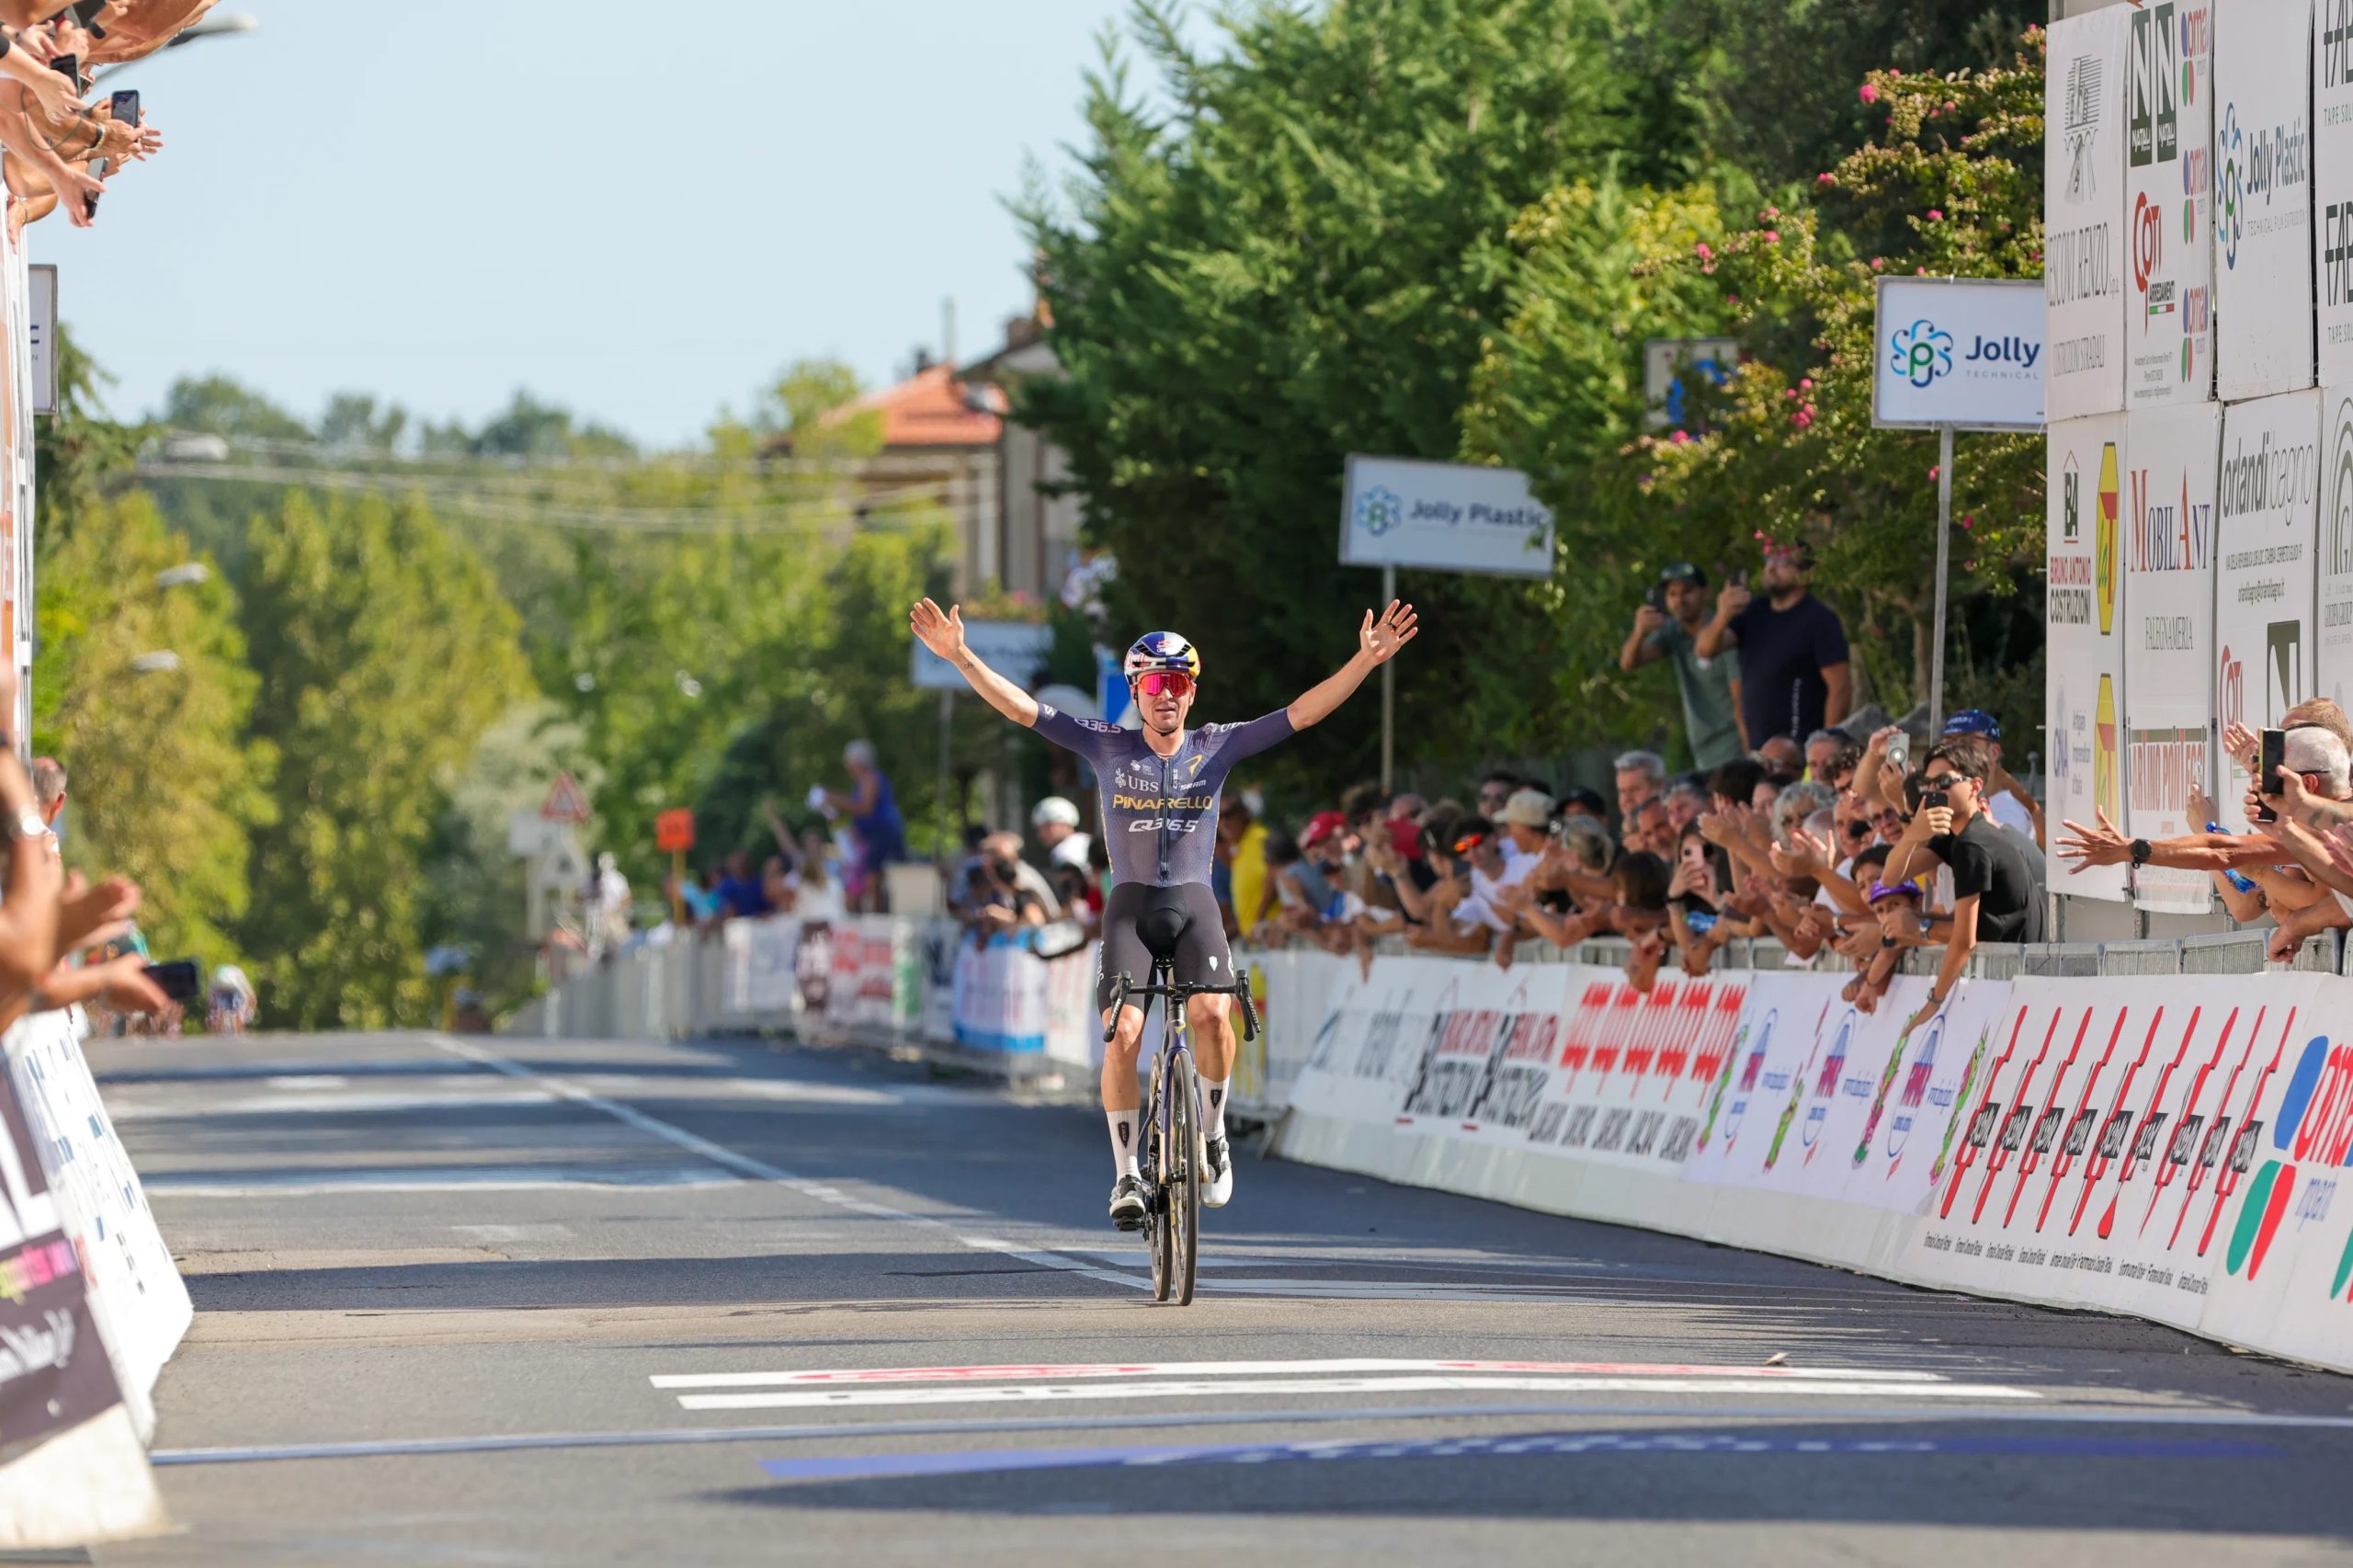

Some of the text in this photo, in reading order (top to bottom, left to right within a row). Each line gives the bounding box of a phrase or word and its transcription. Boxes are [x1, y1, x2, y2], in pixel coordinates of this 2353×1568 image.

[2325, 105, 2339, 127] TAPE
[2247, 117, 2305, 206] Jolly Plastic
[2078, 222, 2109, 300] RENZO
[2327, 325, 2342, 345] TAPE
[1965, 335, 2041, 368] Jolly
[1965, 369, 2040, 380] TECHNICAL
[2222, 429, 2313, 527] orlandi bagno
[1410, 498, 1461, 527] Jolly
[2068, 555, 2092, 585] ANTONIO
[2050, 589, 2091, 624] COSTRUZIONI
[2145, 616, 2193, 651] FALEGNAMERIA
[1128, 775, 1159, 793] UBS
[1180, 779, 1206, 790] SRAM
[1112, 794, 1213, 811] PINARELLO
[1129, 818, 1199, 833] Q36.5
